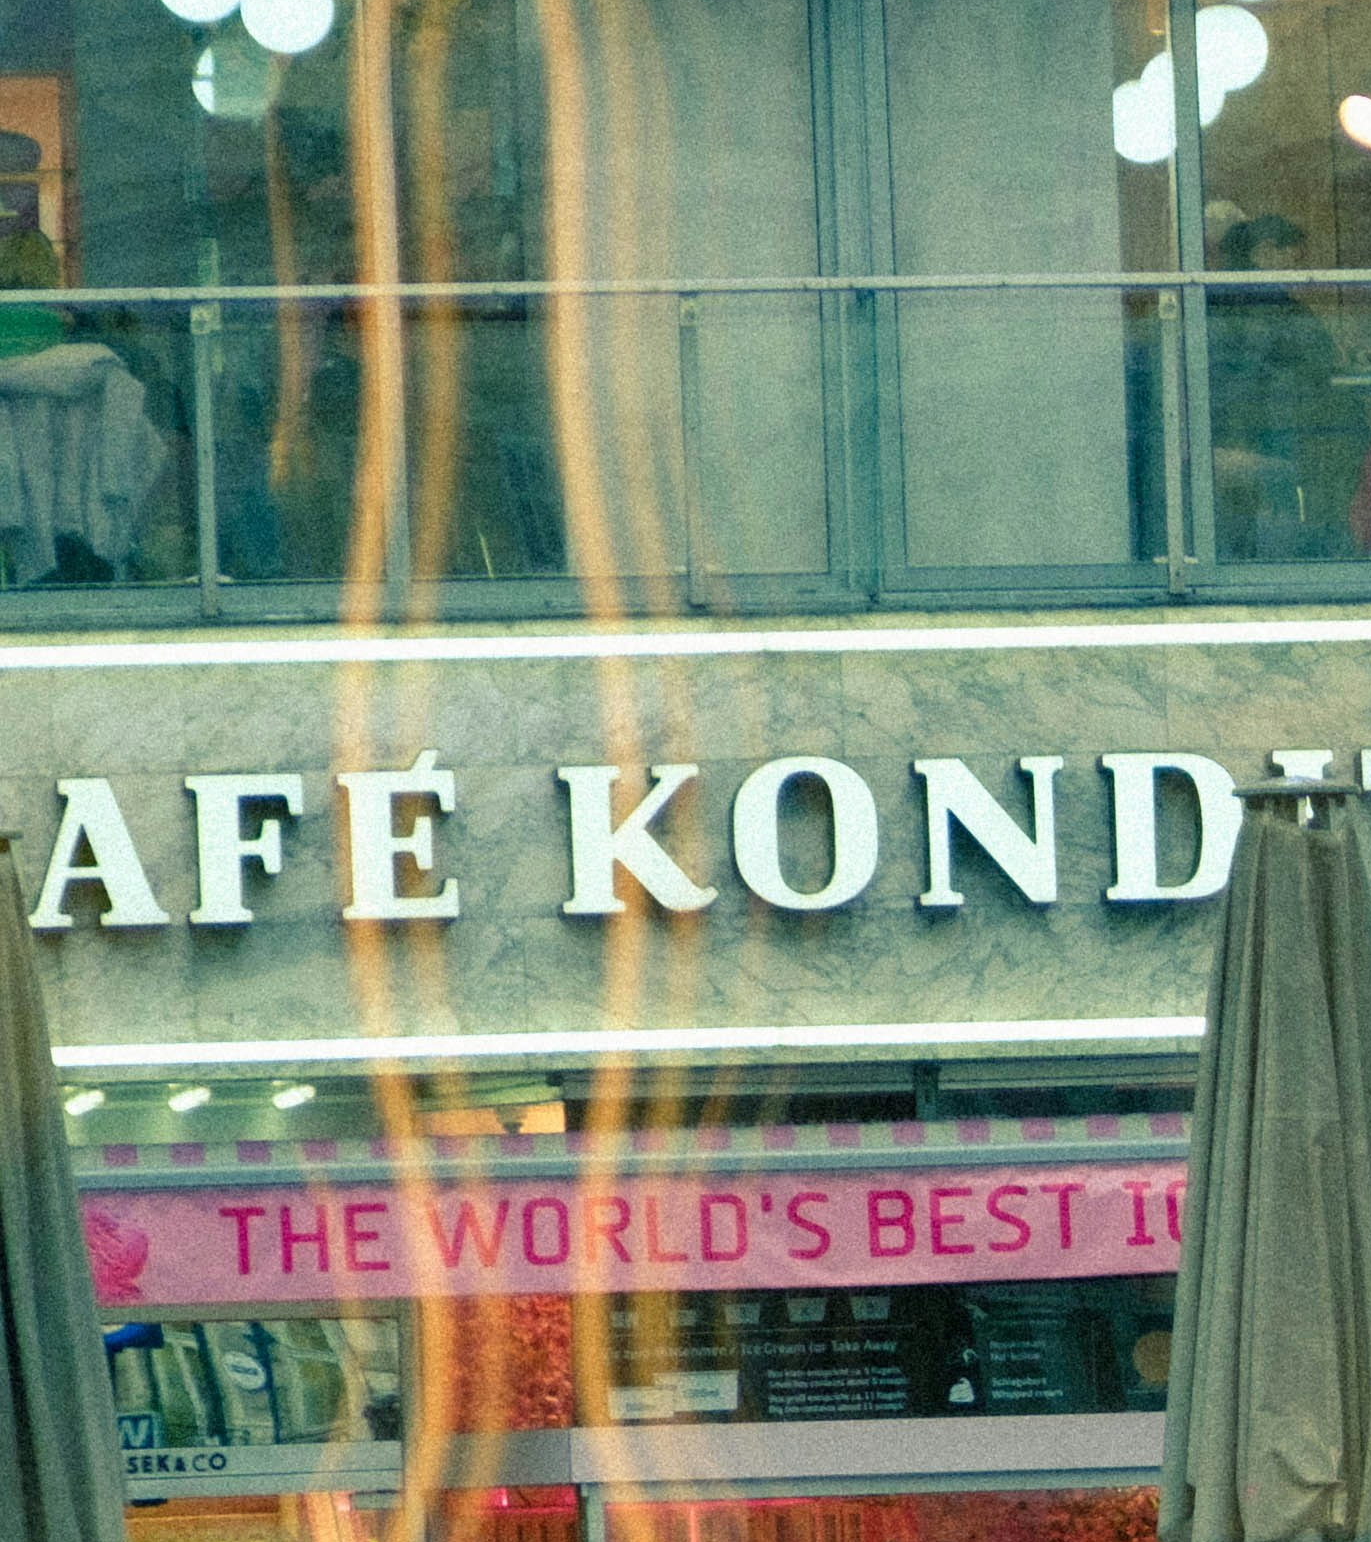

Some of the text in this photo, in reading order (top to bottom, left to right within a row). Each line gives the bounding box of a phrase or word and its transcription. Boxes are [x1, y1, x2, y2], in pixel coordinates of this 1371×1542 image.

[219, 1202, 392, 1275] THE
[426, 1191, 832, 1268] WORLD'S
[868, 1181, 1086, 1260] BEST
